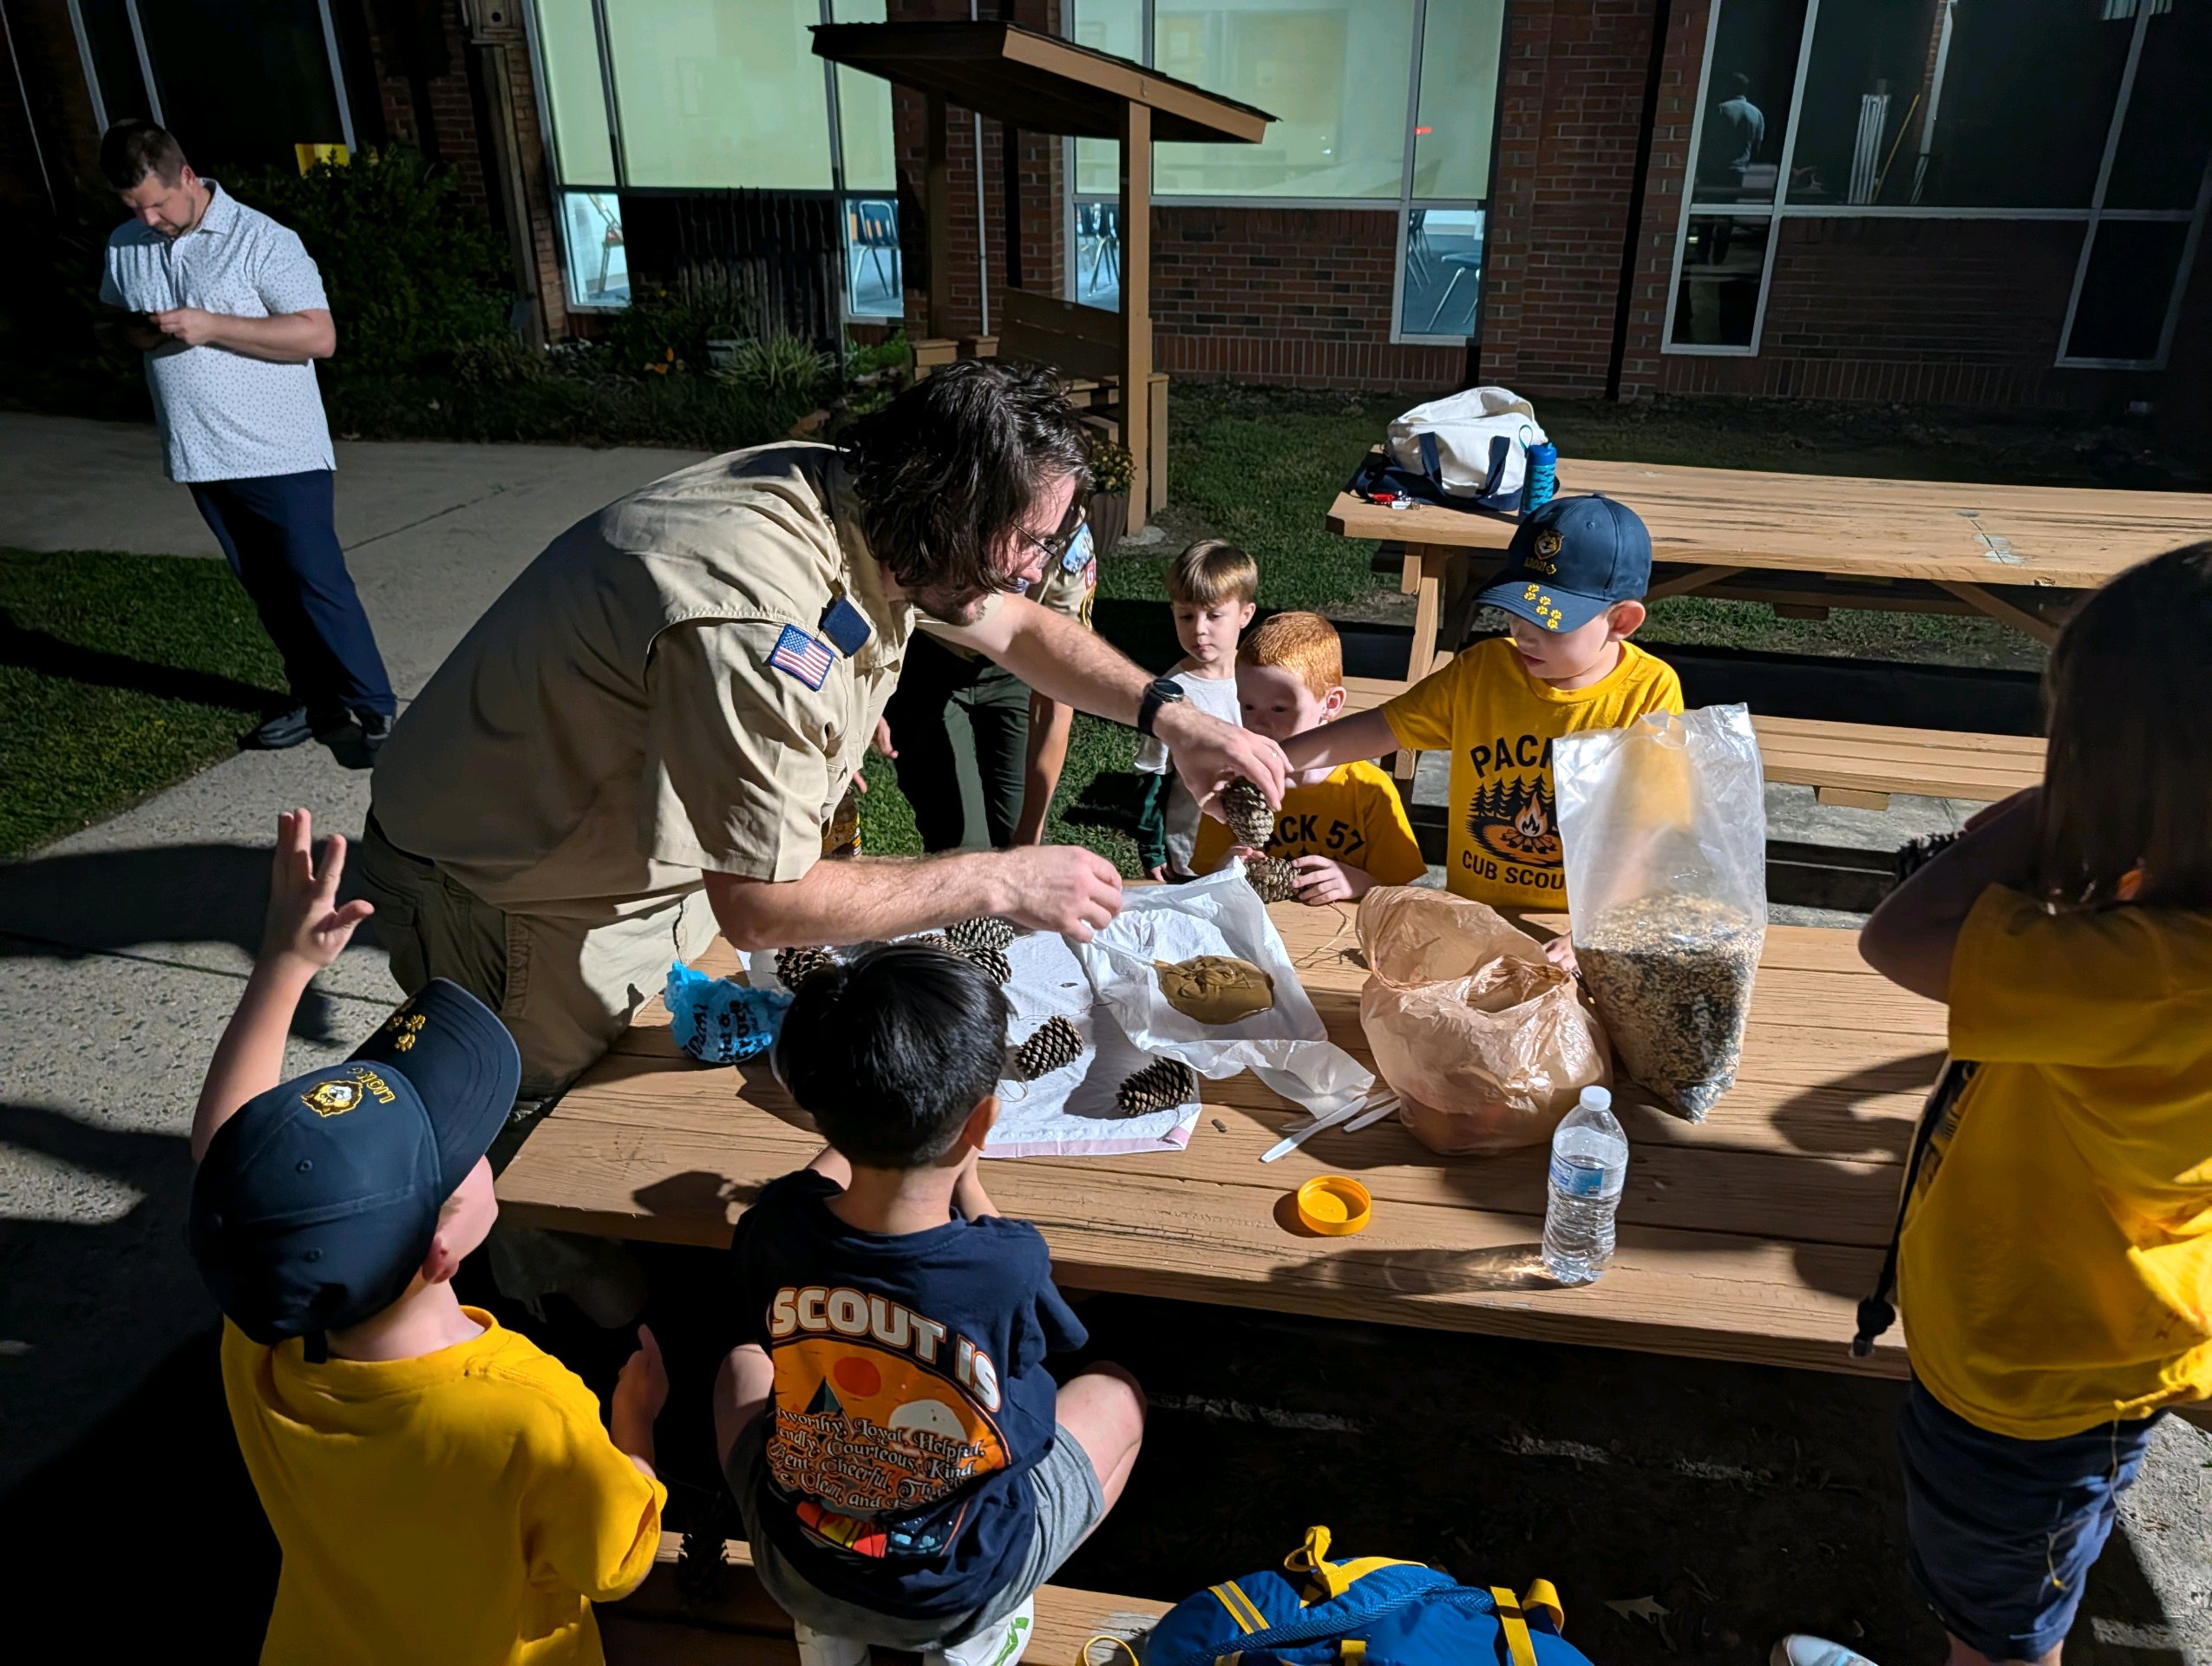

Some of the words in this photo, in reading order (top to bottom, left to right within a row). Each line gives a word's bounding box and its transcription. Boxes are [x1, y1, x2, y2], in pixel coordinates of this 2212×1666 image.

[1325, 818, 1365, 856] 57
[1462, 849, 1498, 881] CUB
[1504, 866, 1566, 890] SCOU
[357, 1069, 396, 1105] LION
[768, 1286, 947, 1365] SCOUT
[955, 1332, 1002, 1413] IS
[847, 1493, 883, 1509] and
